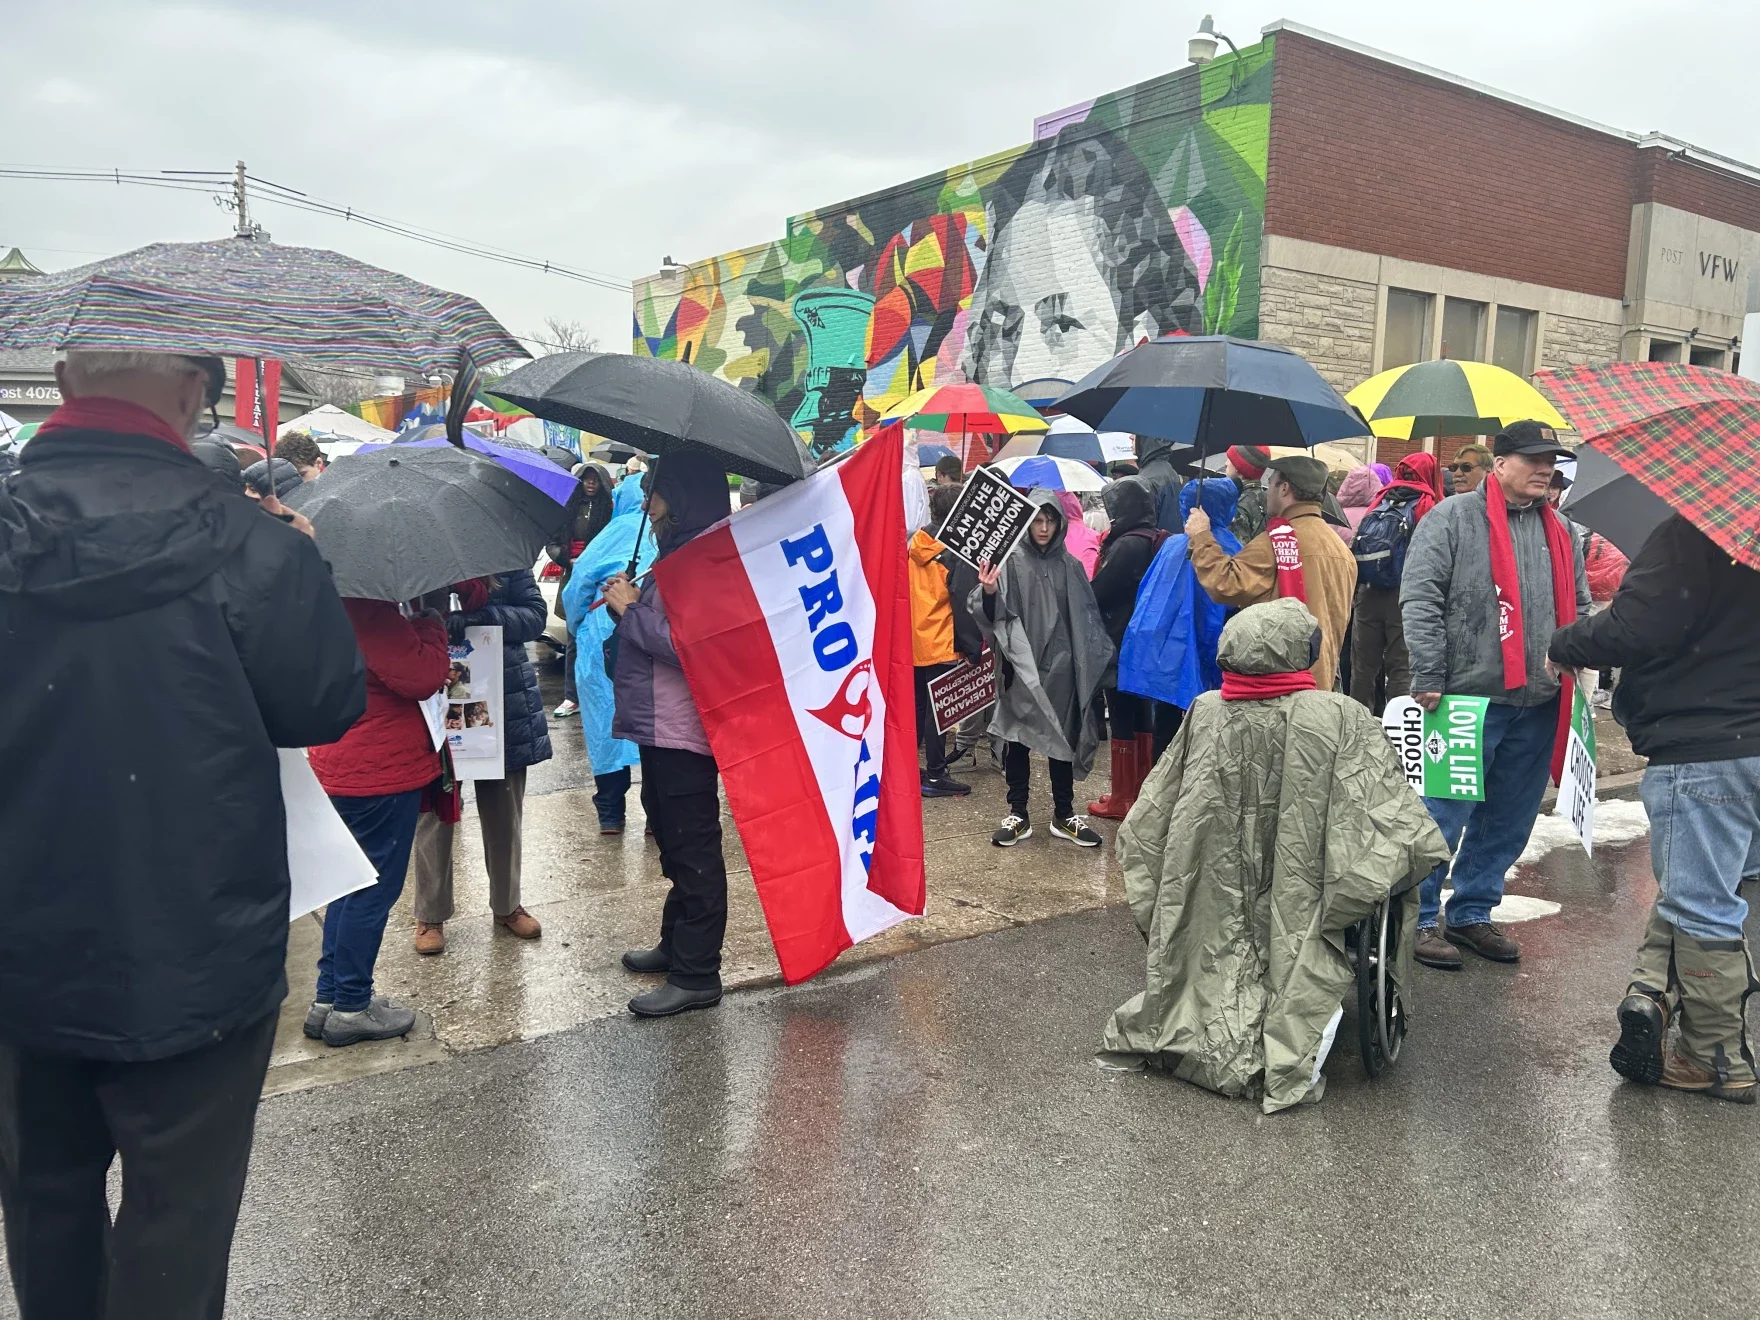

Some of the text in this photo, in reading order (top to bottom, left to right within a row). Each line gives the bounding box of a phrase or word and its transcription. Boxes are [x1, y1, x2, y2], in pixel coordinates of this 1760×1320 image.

[1660, 247, 1739, 283] POST VFW
[25, 386, 61, 400] 4075
[949, 482, 994, 547] I AM THE
[960, 486, 1011, 560] POST-ROE
[976, 498, 1025, 565] GENERATION
[1272, 540, 1297, 549] LOVE
[780, 523, 859, 672] PRO
[934, 666, 982, 699] CONCEPTION
[982, 659, 992, 671] AT
[935, 669, 996, 712] PROTECTION
[944, 687, 986, 719] DEMAND
[1384, 725, 1402, 759] LIF
[1403, 706, 1422, 785] CHOOSE
[1448, 700, 1480, 796] LOVE LIFE
[1571, 736, 1593, 805] CHOOSE
[1572, 785, 1586, 838] LIFE
